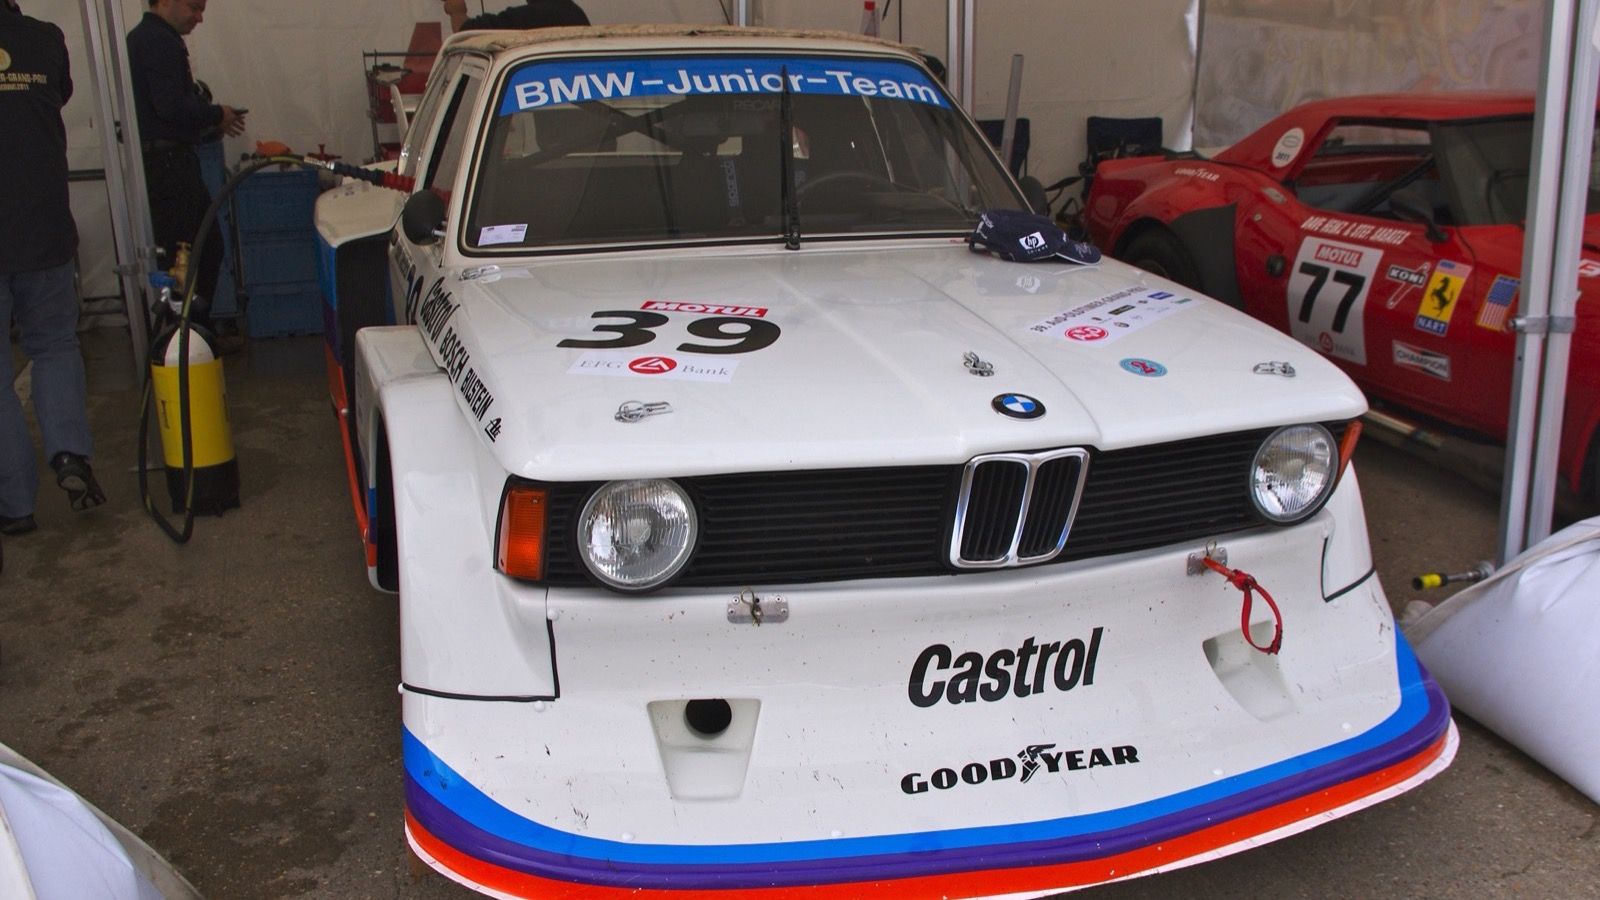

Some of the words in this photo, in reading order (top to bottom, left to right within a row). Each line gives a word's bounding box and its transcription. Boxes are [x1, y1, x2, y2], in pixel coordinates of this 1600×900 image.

[1317, 246, 1360, 265] MOTUL
[1390, 269, 1424, 285] KONI
[420, 276, 461, 344] Castrol
[646, 302, 764, 316] MOTUL
[1299, 262, 1366, 334] 77
[556, 310, 782, 354] 39
[1418, 317, 1446, 333] NART
[439, 327, 470, 384] BOSCH
[579, 359, 625, 370] EFG
[460, 367, 494, 421] BILSTEIN
[908, 626, 1104, 708] Castrol
